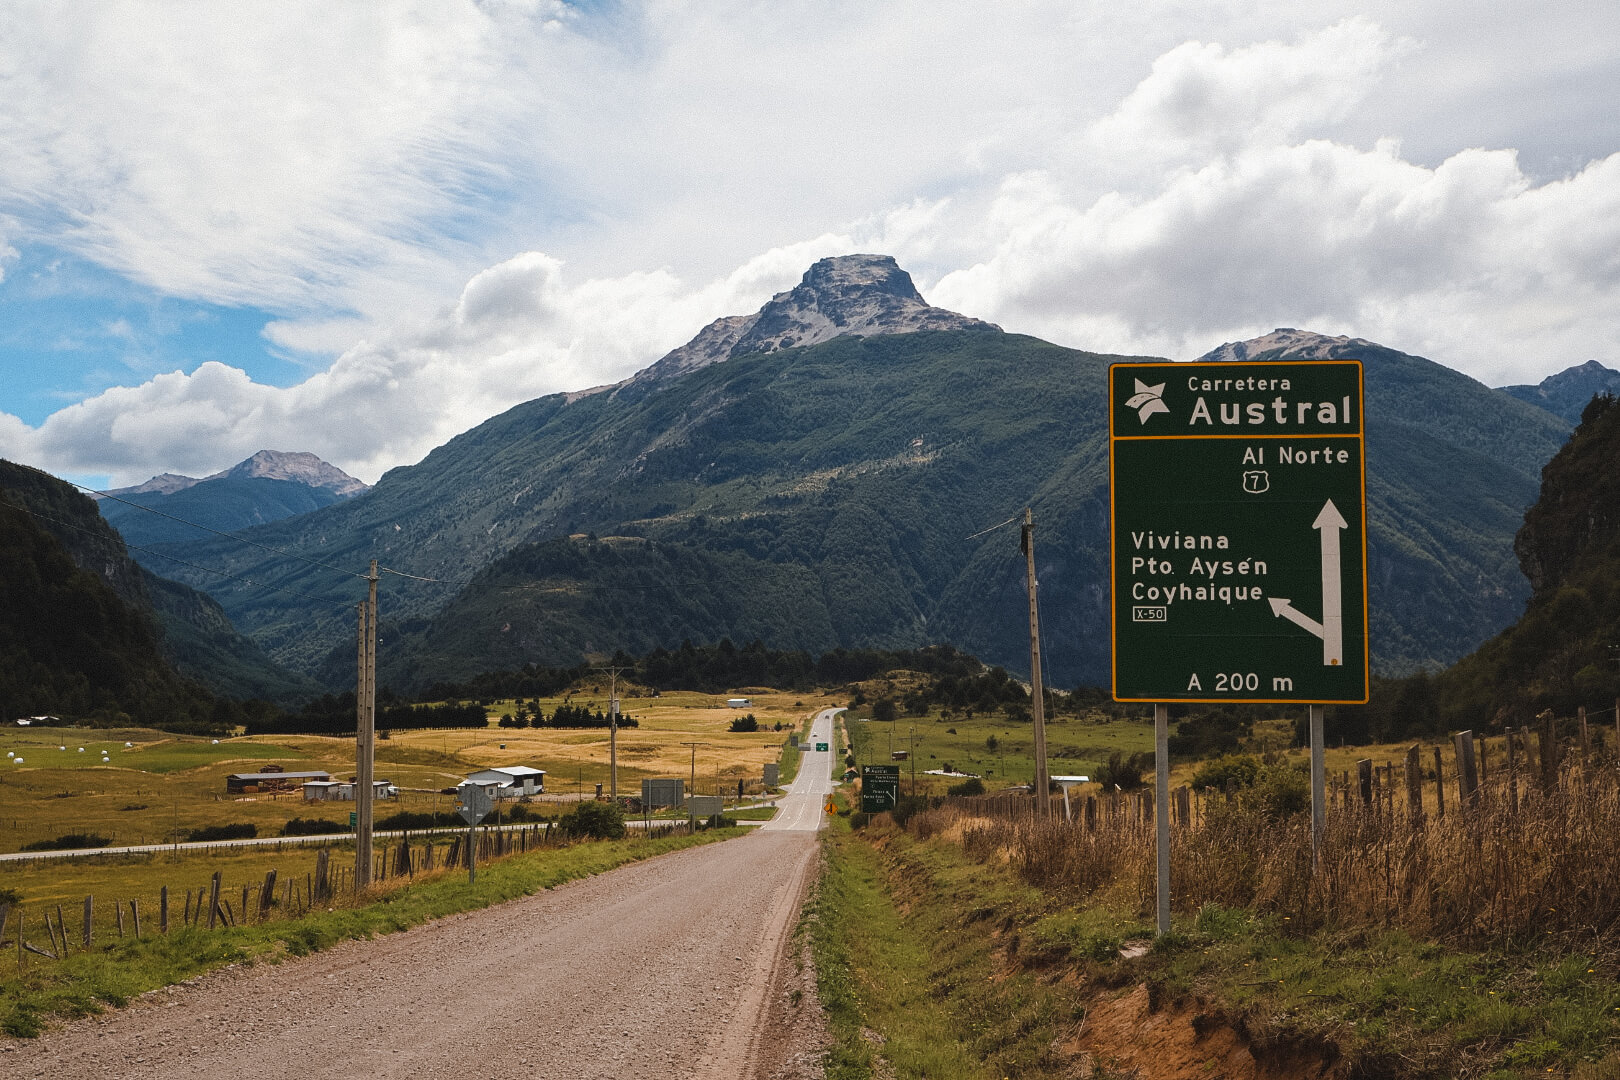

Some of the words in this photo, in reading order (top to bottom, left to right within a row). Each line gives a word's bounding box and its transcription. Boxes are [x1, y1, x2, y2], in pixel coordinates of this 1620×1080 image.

[1188, 377, 1291, 391] Carretera
[1190, 396, 1351, 425] Austral
[1242, 447, 1264, 465] Al
[1280, 447, 1349, 465] Norte
[1251, 475, 1259, 490] 7
[1132, 531, 1229, 550] Viviana
[1132, 557, 1175, 575] Pto.
[1190, 556, 1267, 579] Aysén
[1132, 582, 1263, 605] Coyhaique
[1136, 609, 1164, 619] X-50
[1188, 673, 1202, 691] A
[1216, 673, 1259, 691] 200
[1273, 677, 1293, 692] m
